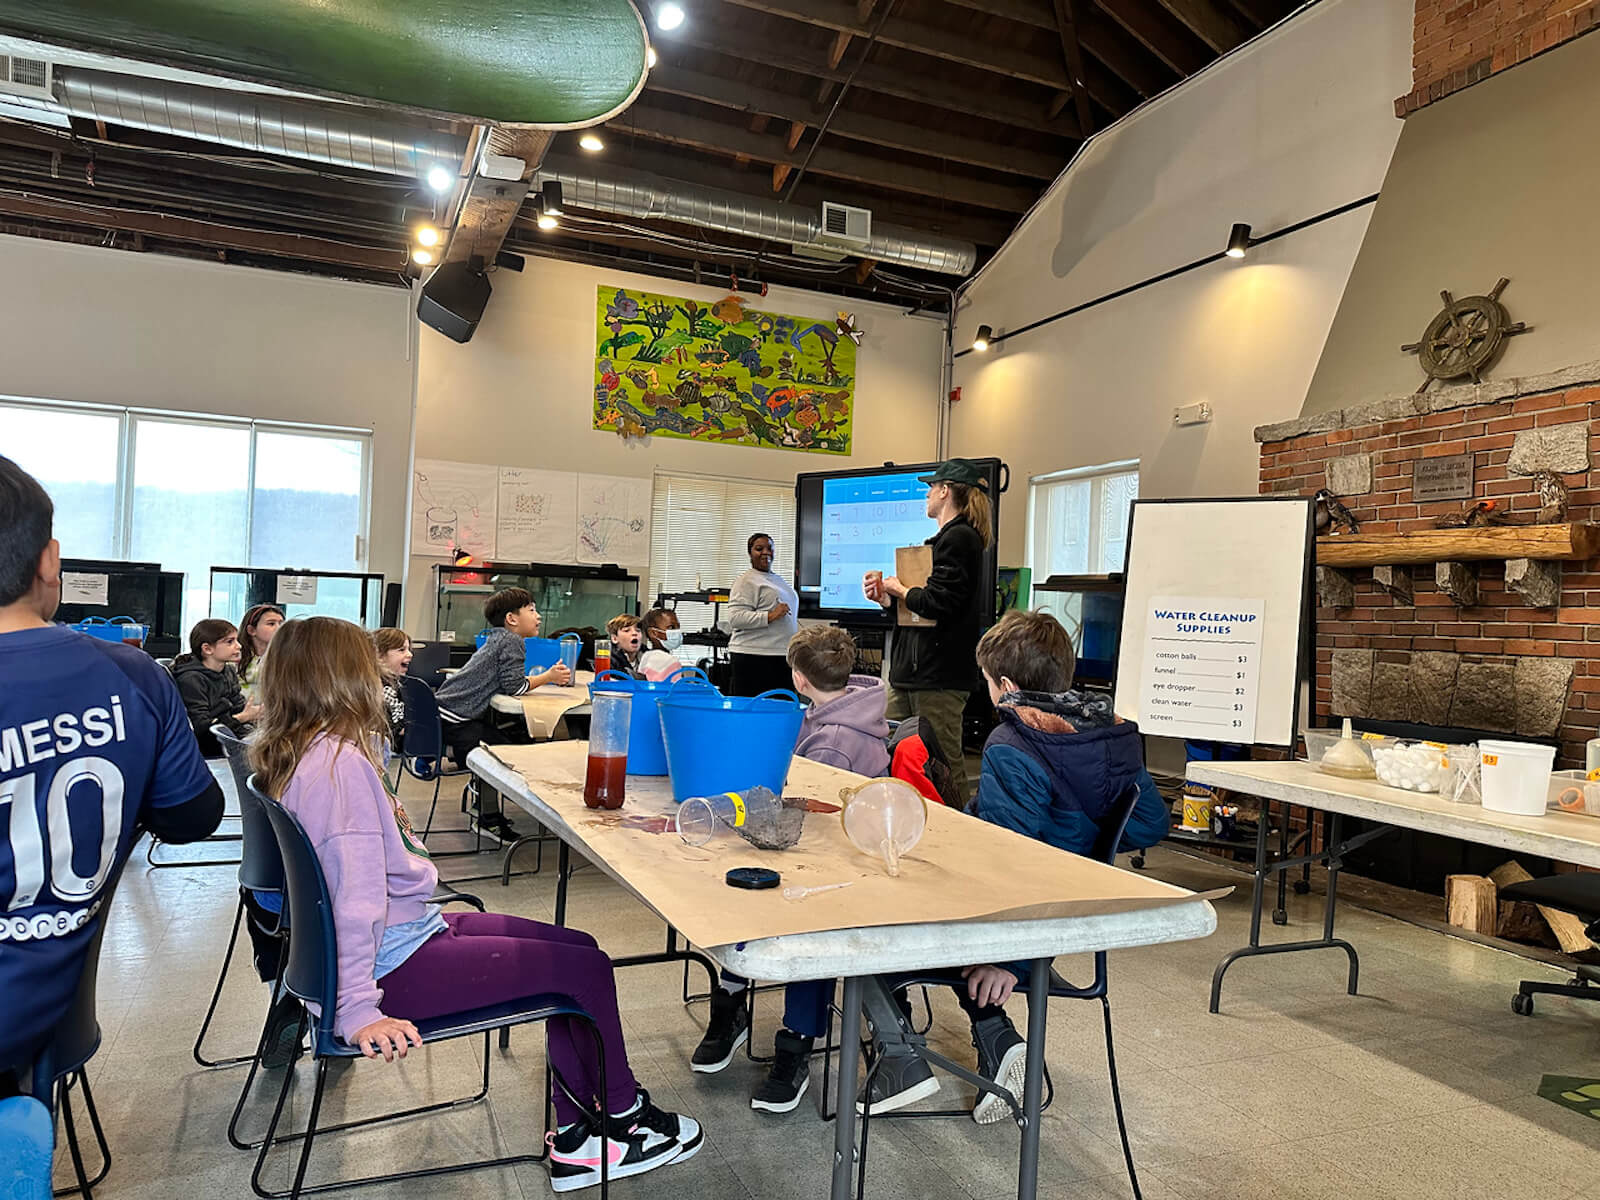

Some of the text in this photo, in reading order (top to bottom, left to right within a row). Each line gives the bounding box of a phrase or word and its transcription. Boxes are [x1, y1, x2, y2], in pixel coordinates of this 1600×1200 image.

[1155, 652, 1179, 660] cotton
[1181, 652, 1197, 660] balls
[1153, 683, 1165, 691] eye
[1167, 683, 1196, 692] dropper
[0, 757, 125, 911] 10
